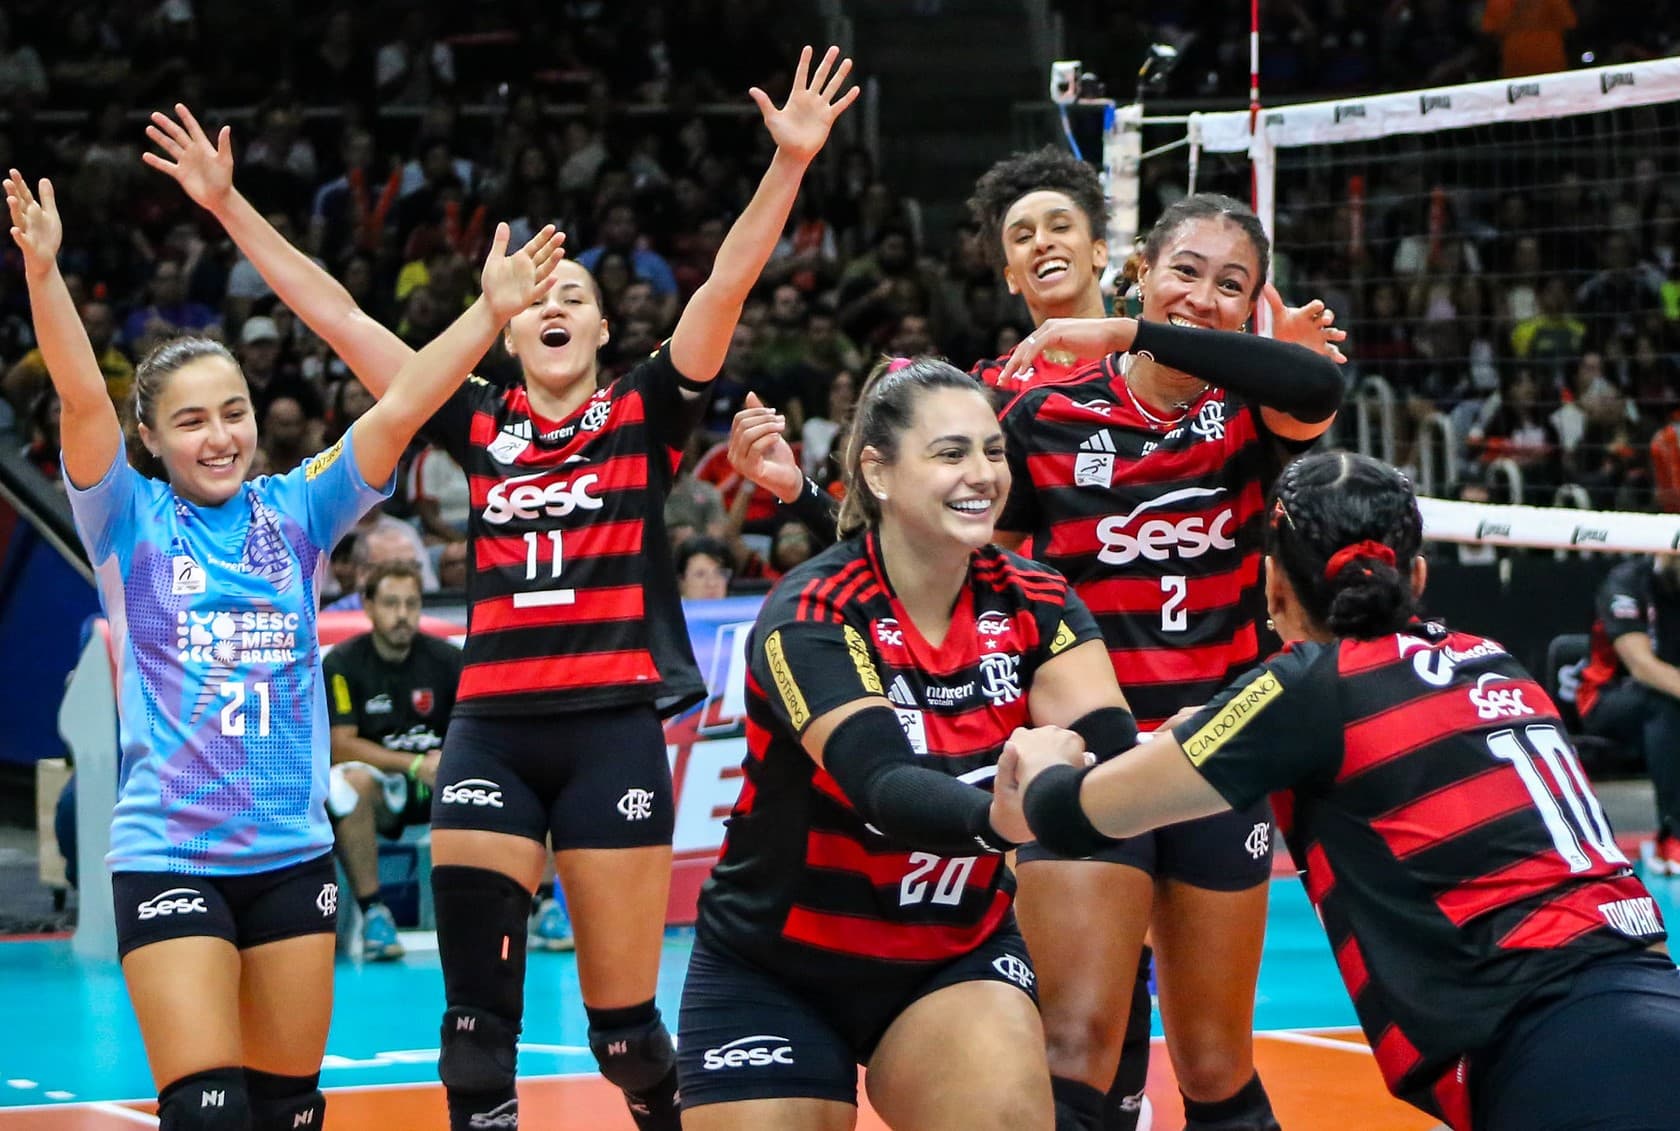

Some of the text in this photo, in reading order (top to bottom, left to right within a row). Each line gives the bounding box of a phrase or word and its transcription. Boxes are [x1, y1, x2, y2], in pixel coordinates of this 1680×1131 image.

[523, 529, 563, 580] 11
[242, 611, 299, 632] SESC
[1161, 575, 1187, 632] 2
[241, 648, 297, 664] BRASIL
[242, 631, 295, 649] MESA
[220, 682, 270, 737] 21
[1486, 724, 1633, 873] 10
[900, 851, 977, 906] 20
